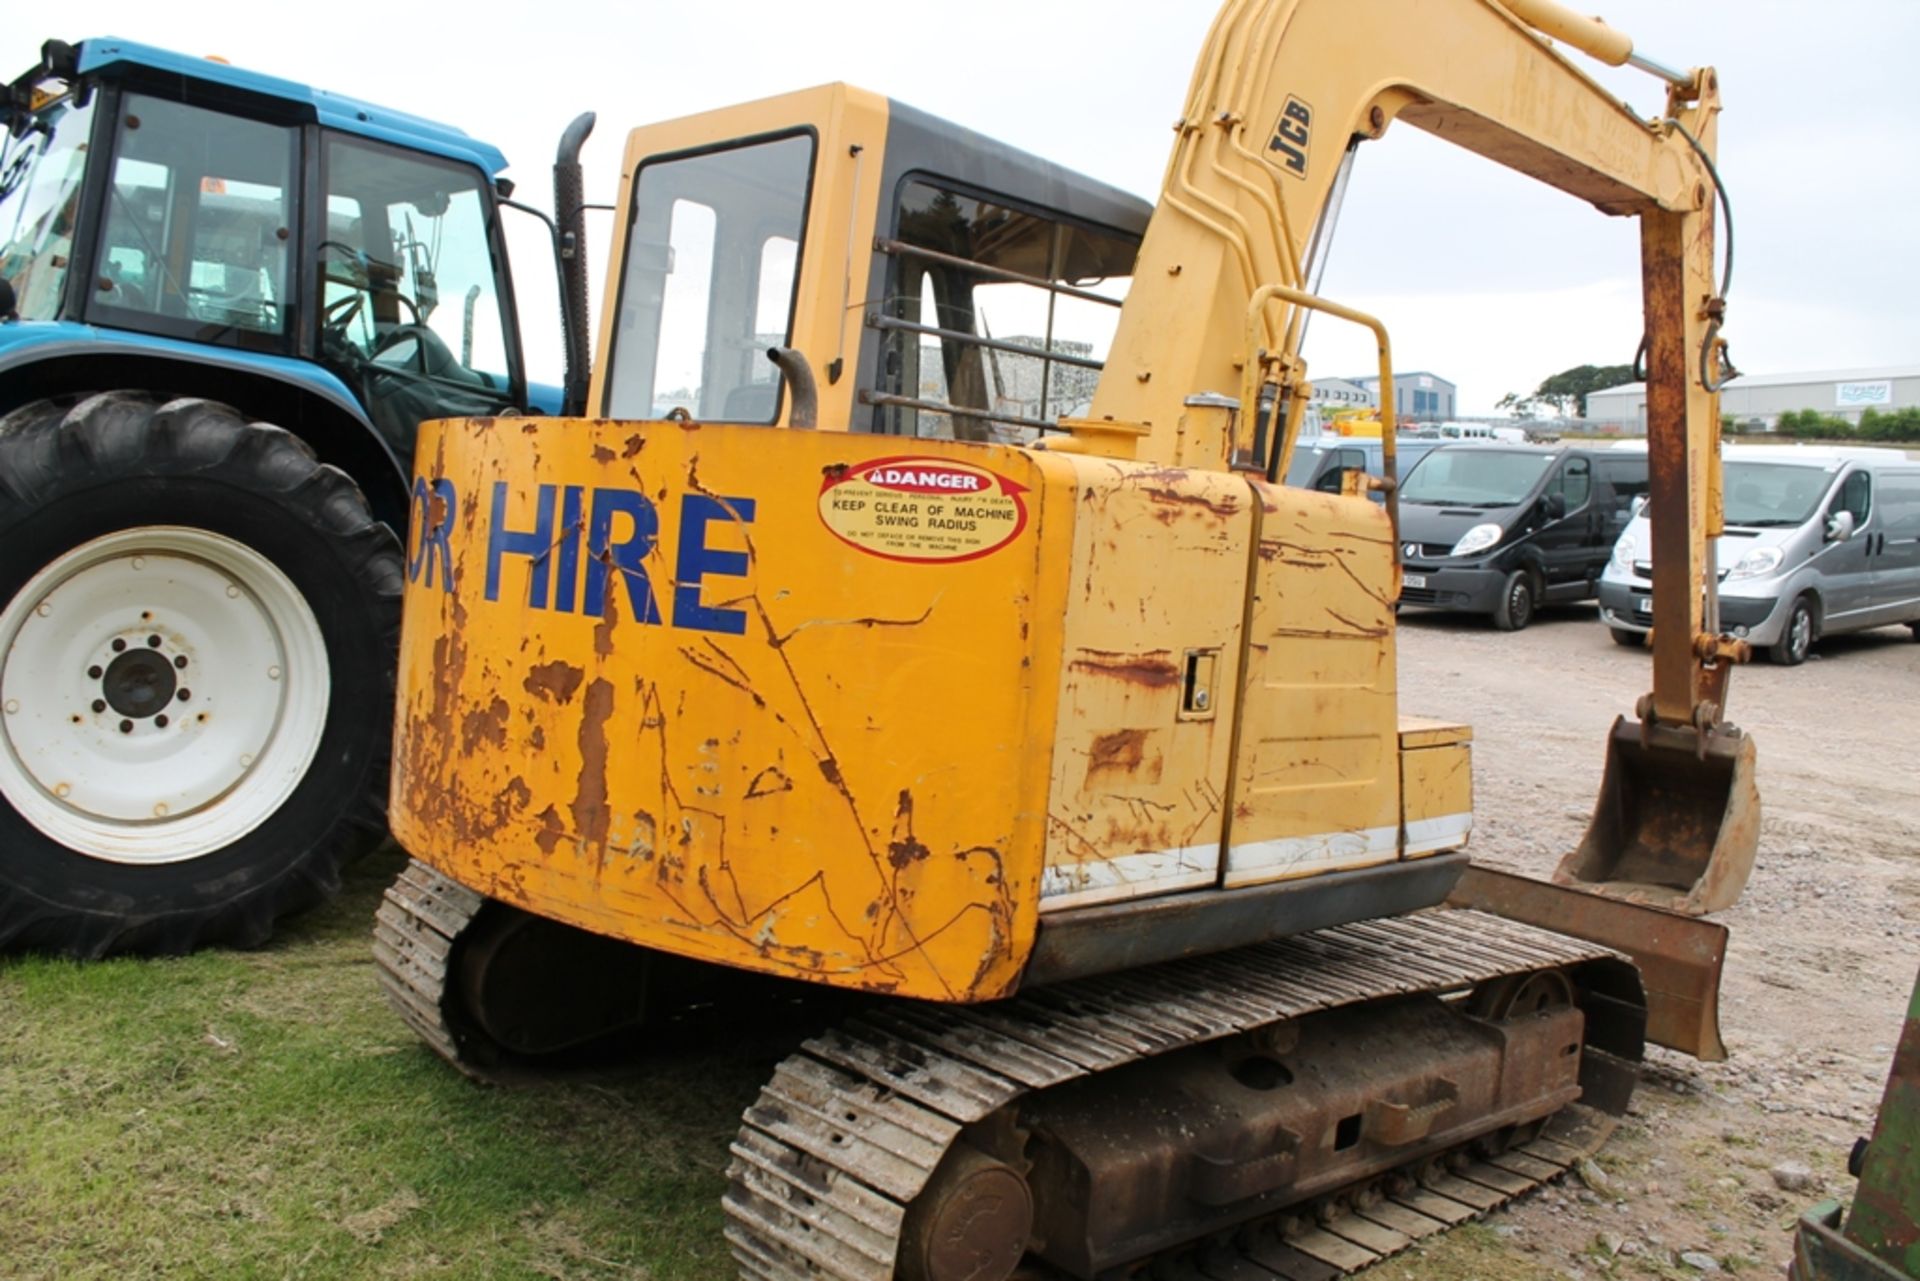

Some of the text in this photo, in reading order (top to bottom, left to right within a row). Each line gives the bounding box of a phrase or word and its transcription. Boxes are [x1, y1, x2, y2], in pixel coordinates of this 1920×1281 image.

[1269, 100, 1310, 174] JCB
[886, 470, 979, 490] DANGER
[832, 500, 1015, 521] KEEP CLEAR OF MACHINE
[875, 515, 977, 532] SWING RADIUS
[877, 532, 904, 540] DEFACE
[928, 543, 958, 551] MACHINE
[483, 480, 756, 636] HIRE
